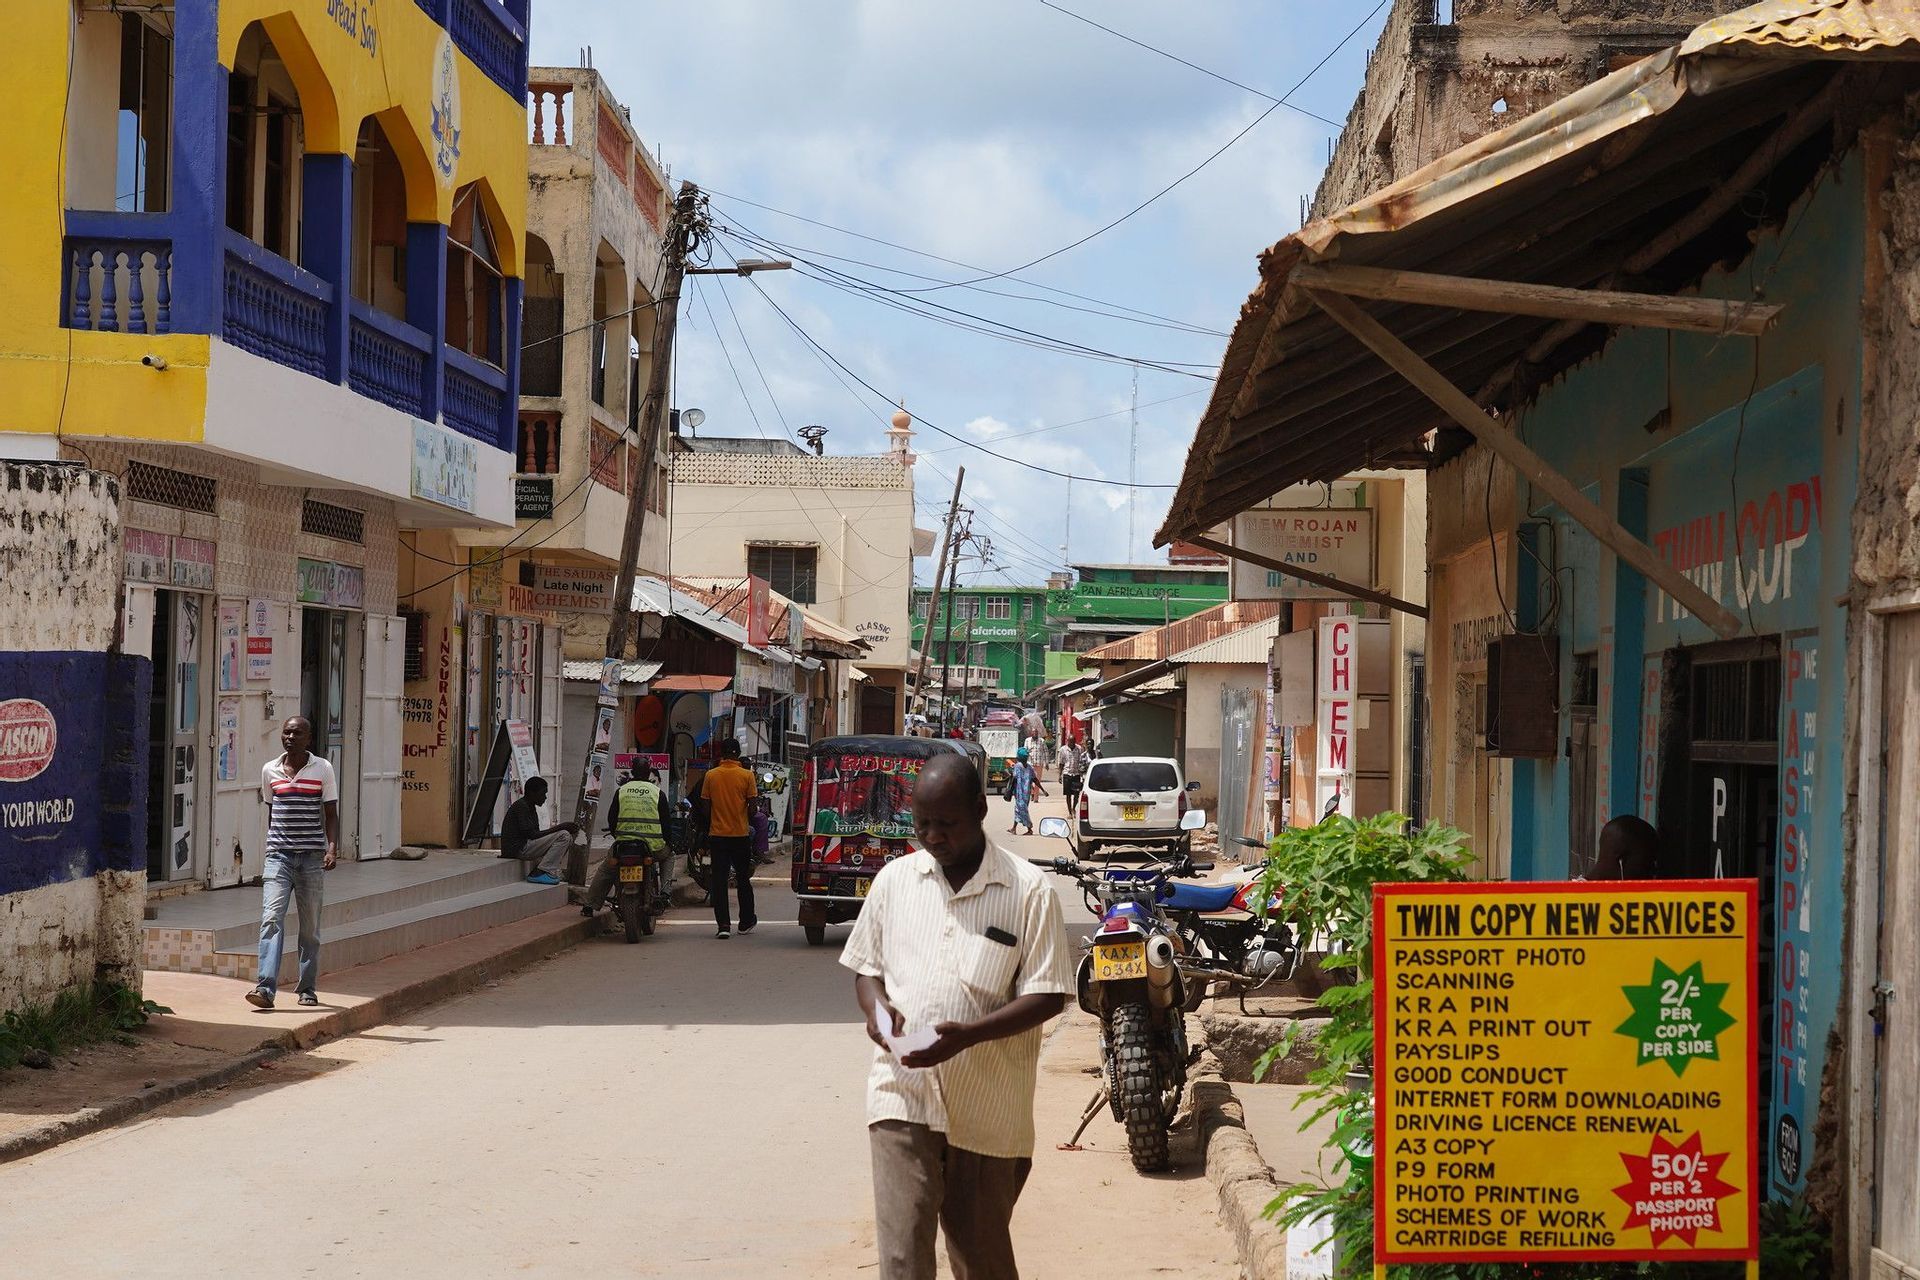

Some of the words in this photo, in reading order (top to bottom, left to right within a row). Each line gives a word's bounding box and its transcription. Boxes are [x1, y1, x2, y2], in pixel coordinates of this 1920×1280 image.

[360, 7, 377, 58] Say
[1247, 519, 1287, 532] NEW
[1294, 519, 1357, 532] ROJAN
[1260, 535, 1344, 549] CHEMIST
[1285, 552, 1318, 563] AND
[538, 566, 560, 577] THE
[564, 568, 614, 581] SAUDAS
[1653, 511, 1727, 623] TWIN
[543, 579, 569, 591] Late
[576, 582, 604, 595] Night
[1082, 585, 1102, 596] PAN
[1107, 586, 1143, 597] AFRICA
[1147, 588, 1180, 598] LODGE
[534, 592, 609, 610] CHEMIST
[855, 621, 891, 635] CLASSIC
[436, 627, 450, 747] INSURANCE
[402, 744, 438, 758] IGHT
[616, 761, 630, 769] NAIL
[648, 761, 668, 770] ALON
[627, 787, 650, 797] mogo
[2, 801, 35, 828] YOUR
[36, 798, 74, 826] WORLD
[844, 846, 889, 855] PIGGIO
[1779, 650, 1802, 1106] PASSPORT
[1397, 904, 1460, 936] TWIN
[1470, 904, 1536, 936] COPY
[1546, 903, 1600, 935] NEW
[1609, 901, 1735, 935] SERVICES
[1395, 949, 1504, 966] PASSPORT
[1517, 948, 1585, 966] PHOTO
[1102, 961, 1144, 977] 034X
[1396, 972, 1514, 990] SCANNING
[1471, 996, 1509, 1013] PIN
[1660, 1007, 1692, 1021] PER
[1469, 1020, 1535, 1037] PRINT
[1544, 1020, 1591, 1037] OUT
[1655, 1023, 1702, 1038] COPY
[1396, 1043, 1500, 1060] PAYSLIPS
[1642, 1042, 1673, 1057] PER
[1677, 1040, 1714, 1055] SIDE
[1394, 1066, 1452, 1084] GOOD
[1461, 1067, 1568, 1084] CONDUCT
[1395, 1090, 1494, 1108] INTERNET
[1502, 1091, 1557, 1108] FORM
[1566, 1091, 1721, 1110] DOWNLOADING
[1395, 1114, 1483, 1131] DRIVING
[1493, 1115, 1576, 1132] LICENCE
[1586, 1116, 1683, 1134] RENEWAL
[1395, 1138, 1426, 1155] A3
[1433, 1138, 1495, 1155] COPY
[1437, 1162, 1495, 1179] FORM
[1396, 1184, 1464, 1203] PHOTO
[1475, 1186, 1579, 1204] PRINTING
[1650, 1180, 1685, 1196] PER
[1690, 1180, 1703, 1194] 2
[1635, 1197, 1716, 1216] PASSPORT
[1396, 1208, 1491, 1226] SCHEMES
[1500, 1209, 1526, 1226] OF
[1538, 1210, 1606, 1228] WORK
[1650, 1214, 1714, 1232] PHOTOS
[1395, 1230, 1507, 1246] CARTRIDGE
[1520, 1231, 1615, 1247] REFILLING
